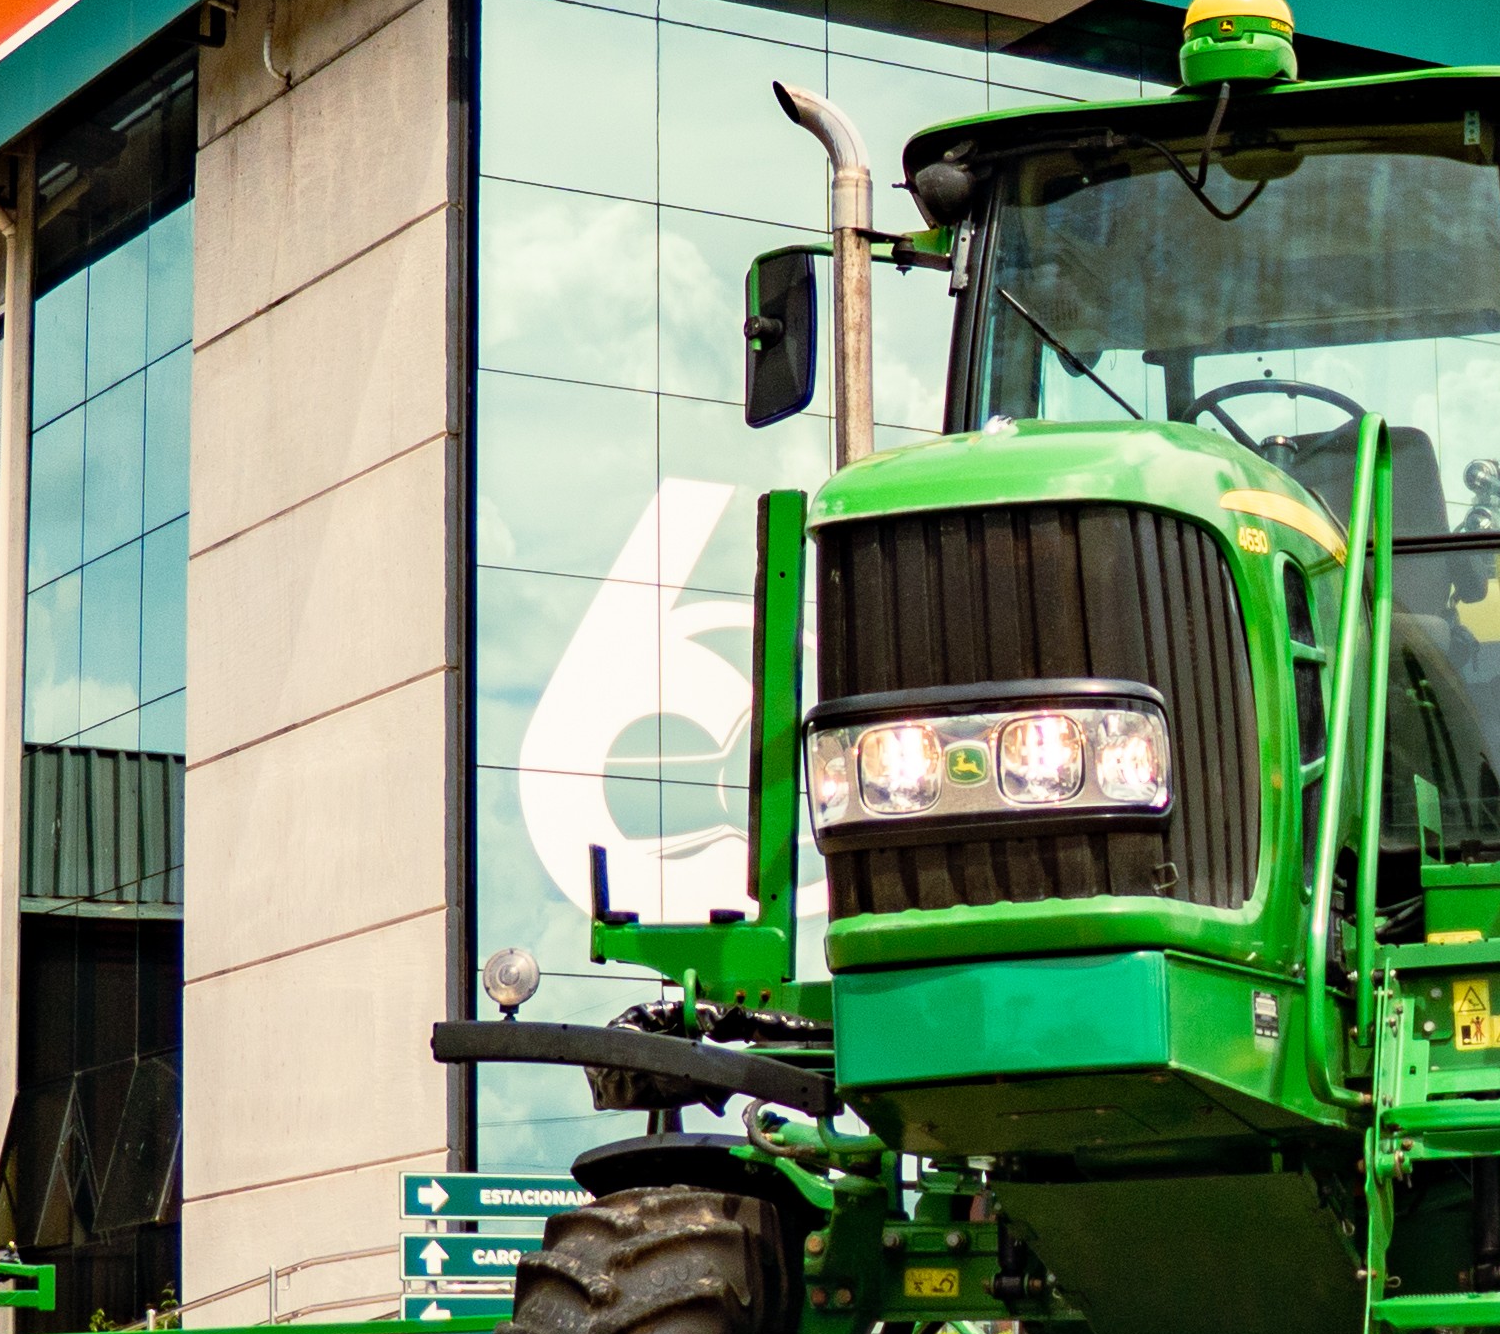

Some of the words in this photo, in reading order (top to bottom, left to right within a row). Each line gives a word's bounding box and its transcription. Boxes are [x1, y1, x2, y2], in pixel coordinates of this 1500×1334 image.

[1238, 526, 1268, 555] 4630
[480, 1189, 596, 1206] ESTACIONAM
[472, 1249, 527, 1265] CARG
